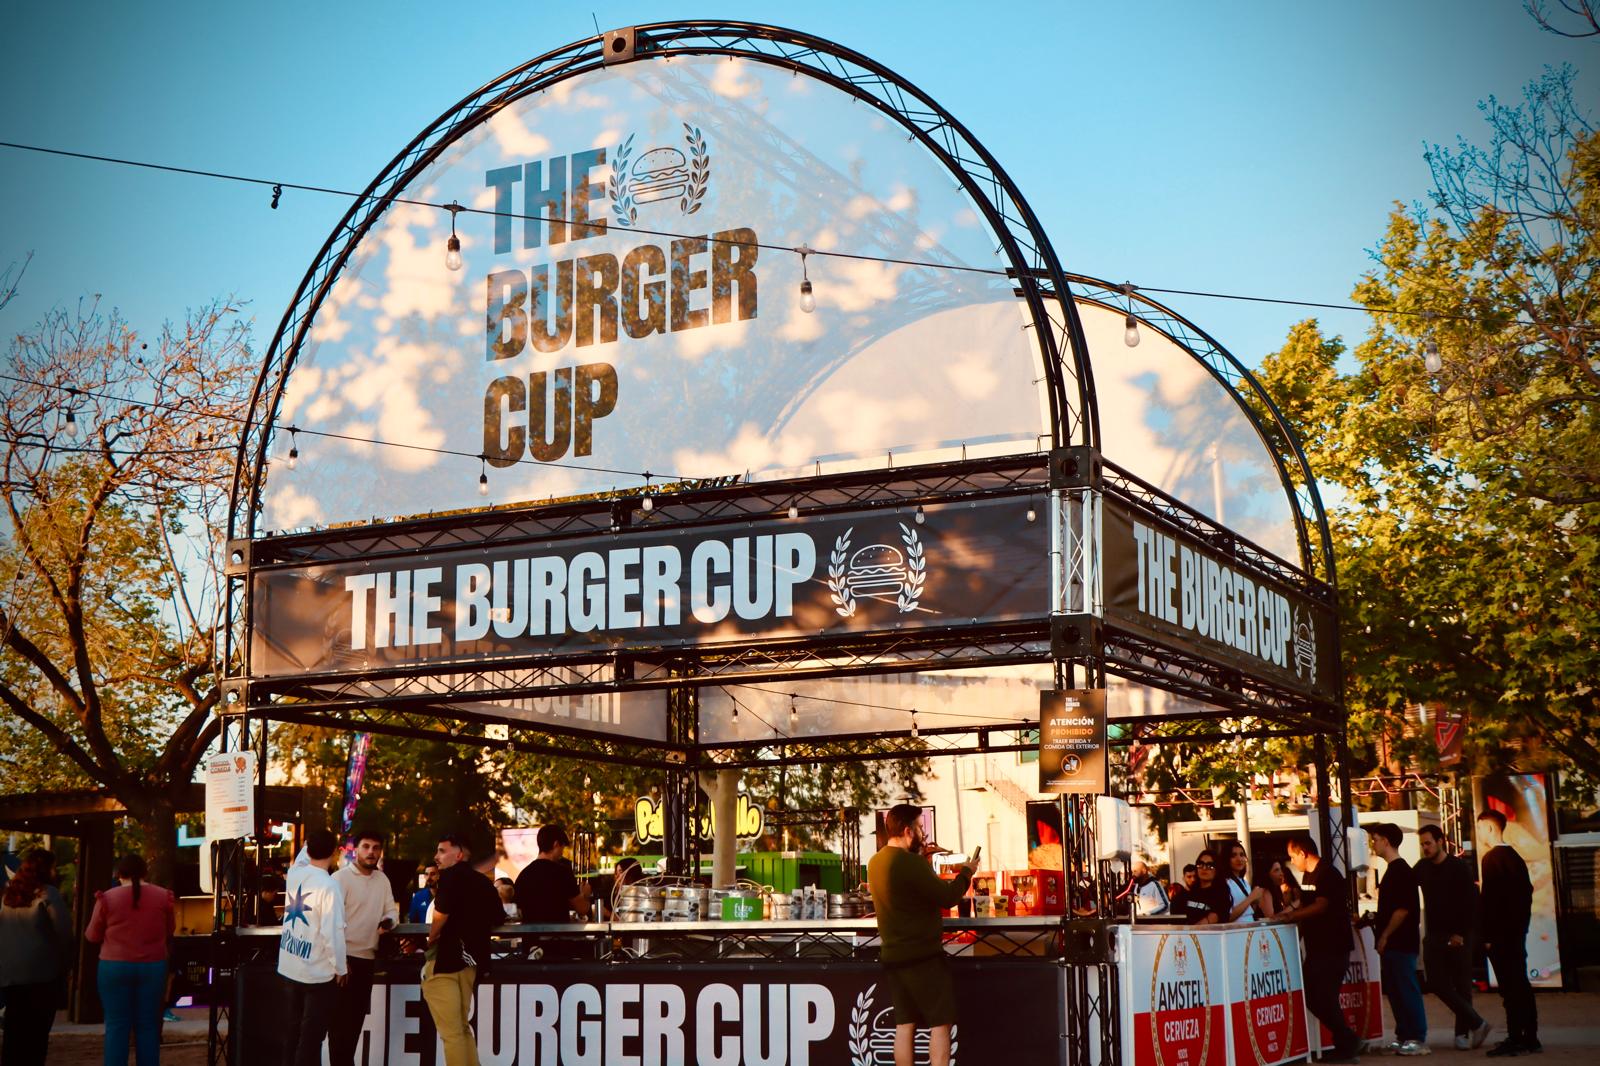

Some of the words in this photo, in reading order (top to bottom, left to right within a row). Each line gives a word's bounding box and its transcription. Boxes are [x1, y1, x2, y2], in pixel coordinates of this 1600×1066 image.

[485, 147, 608, 255] THE
[486, 227, 759, 362] BURGER
[483, 362, 619, 469] CUP
[344, 567, 443, 650] THE
[454, 545, 682, 642] BURGER
[694, 532, 817, 624] CUP
[1133, 520, 1178, 625] THE
[1180, 544, 1258, 657] BURGER
[1257, 585, 1292, 669] CUP
[1050, 716, 1094, 726] ATENCIÓN
[321, 984, 421, 1066] HE
[436, 983, 686, 1066] URGER
[696, 983, 836, 1066] CUP
[1158, 979, 1204, 1011] AMSTEL
[1251, 969, 1286, 1000] AMSTEL
[1257, 1003, 1285, 1026] CERVEZA
[1164, 1018, 1200, 1042] CERVEZA
